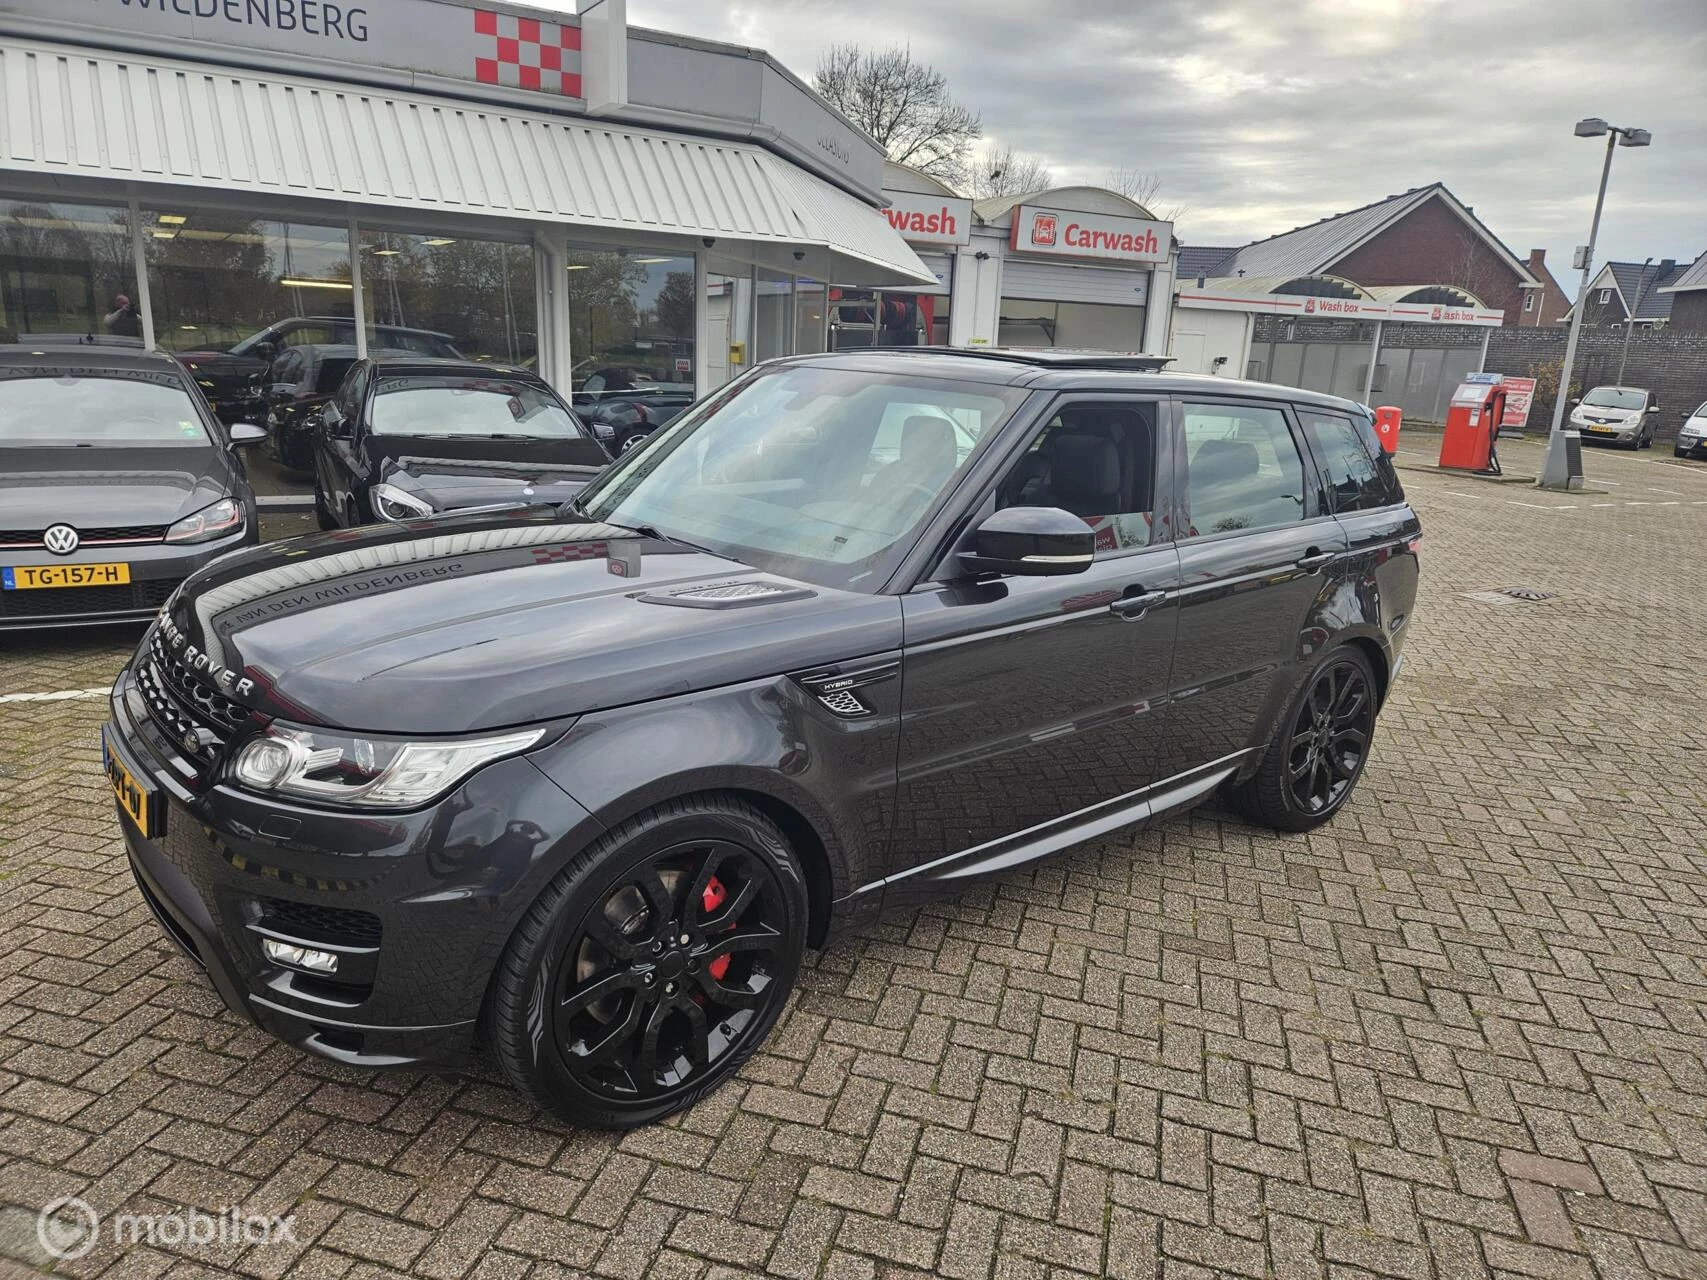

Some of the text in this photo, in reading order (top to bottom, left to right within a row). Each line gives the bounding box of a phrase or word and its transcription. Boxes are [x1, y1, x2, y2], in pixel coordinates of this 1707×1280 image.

[1064, 223, 1158, 254] Carwash
[1319, 300, 1359, 313] Wash box
[1461, 310, 1474, 321] box
[24, 566, 118, 585] TG-157-H
[183, 645, 255, 697] ROVER
[824, 679, 853, 690] HYBRID
